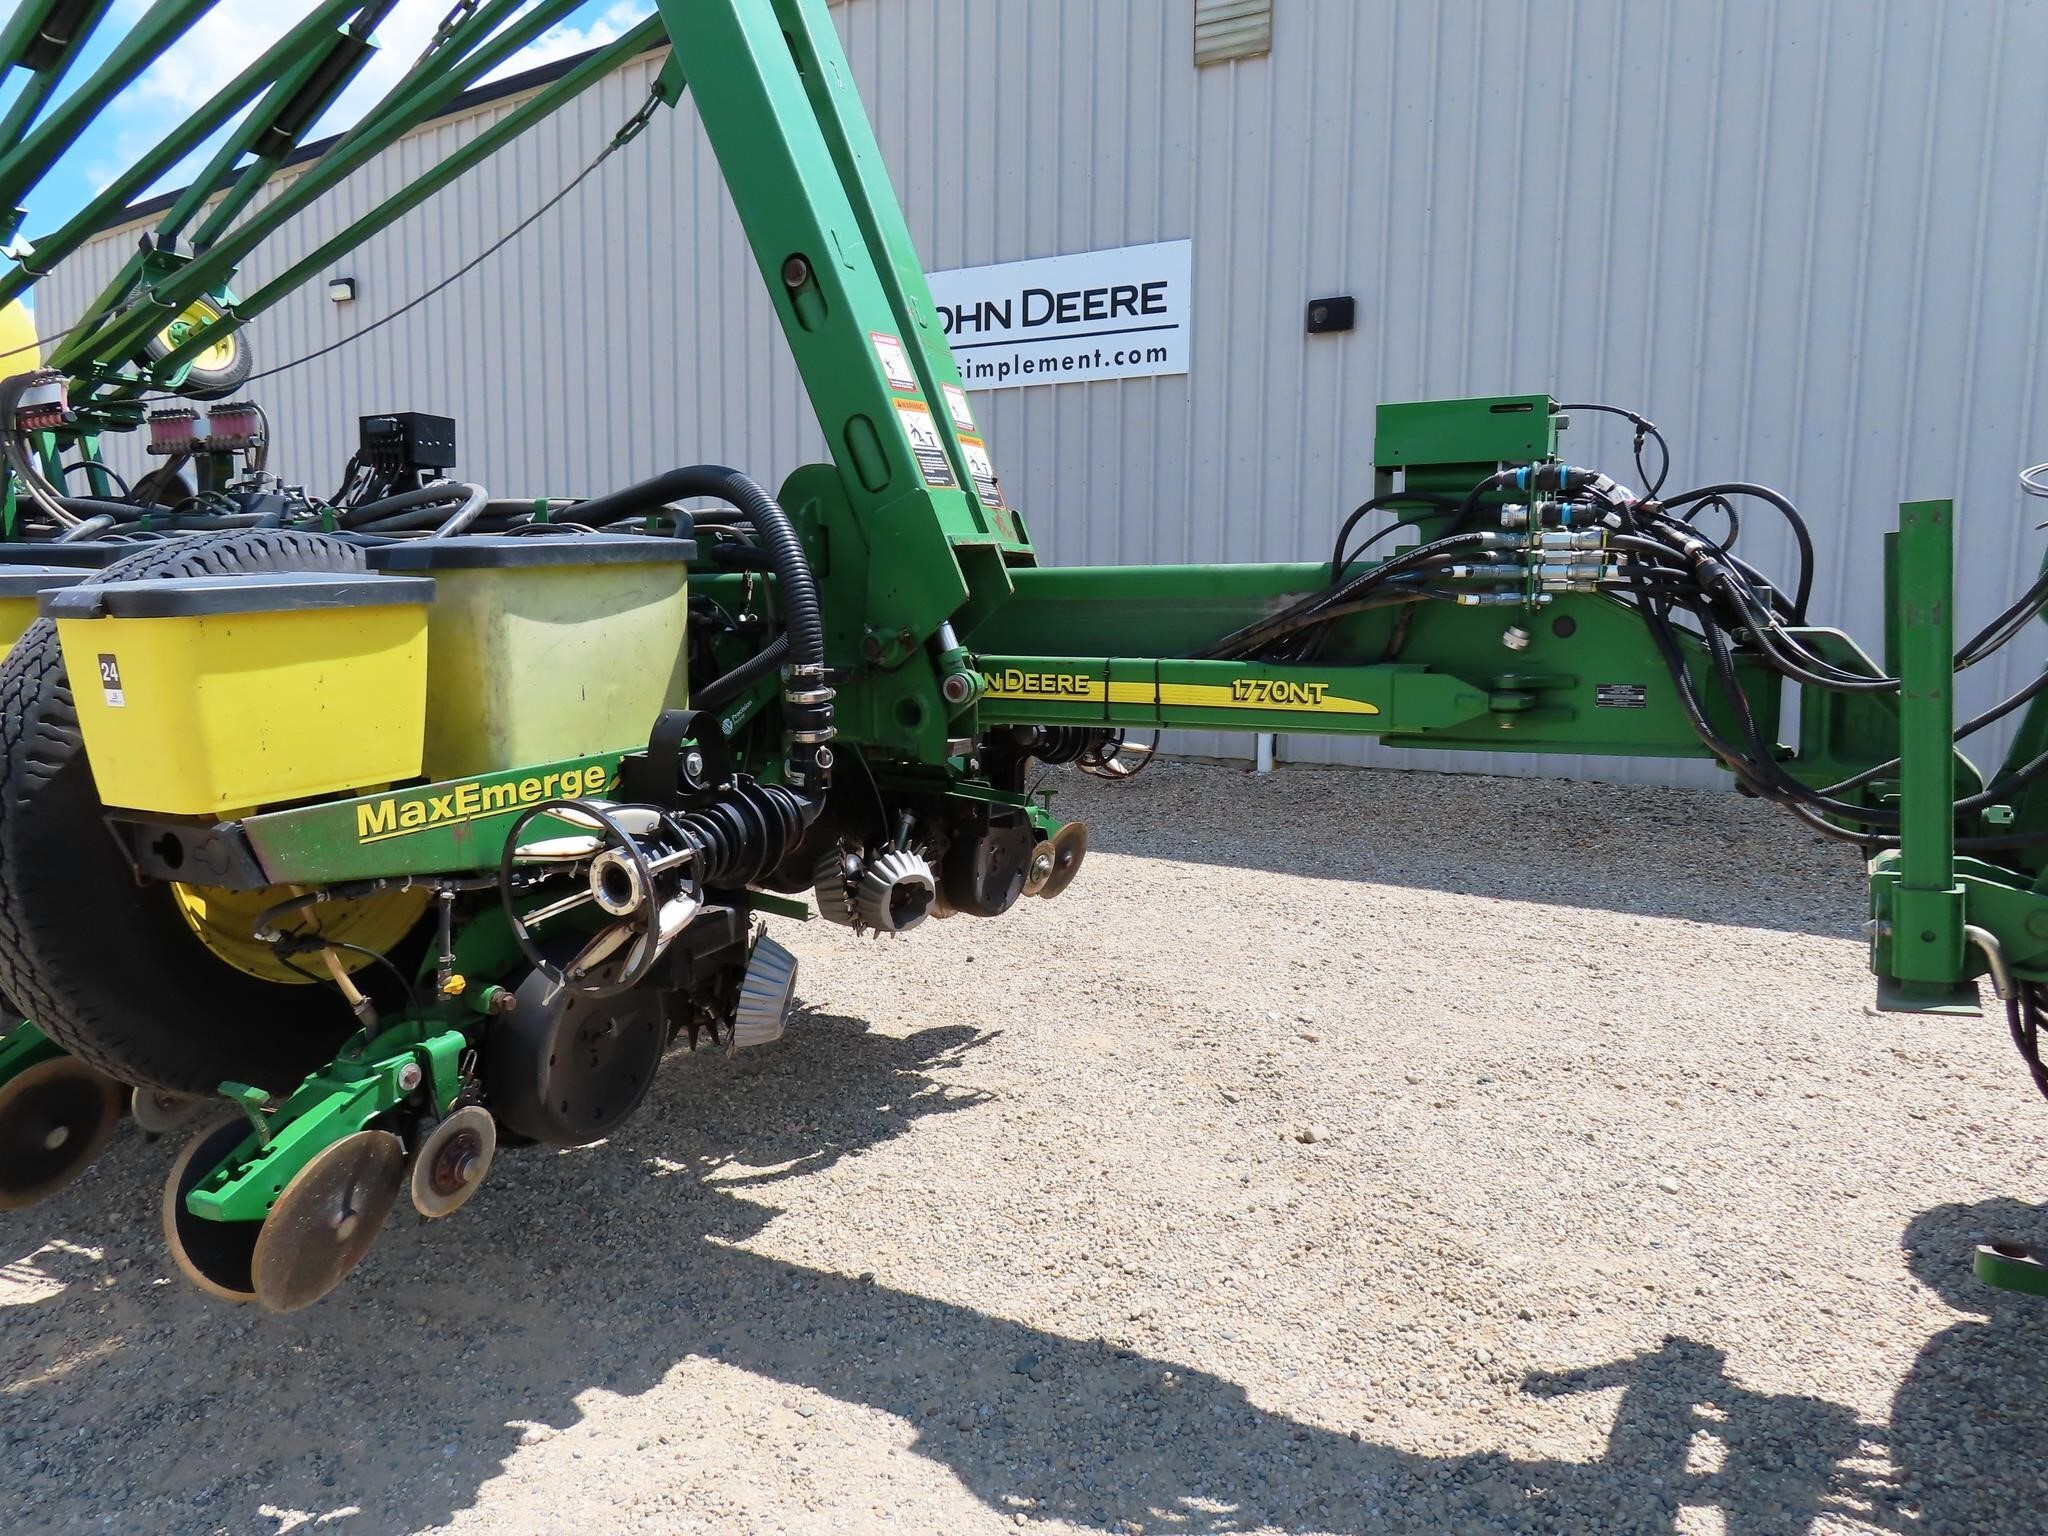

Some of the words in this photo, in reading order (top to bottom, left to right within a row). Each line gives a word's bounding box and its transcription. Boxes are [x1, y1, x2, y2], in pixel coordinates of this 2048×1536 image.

[1022, 281, 1168, 327] DEERE
[101, 662, 119, 682] 24
[1005, 669, 1090, 694] DEERE
[1232, 678, 1329, 705] 1770NT
[356, 764, 607, 838] MaxEmerge
